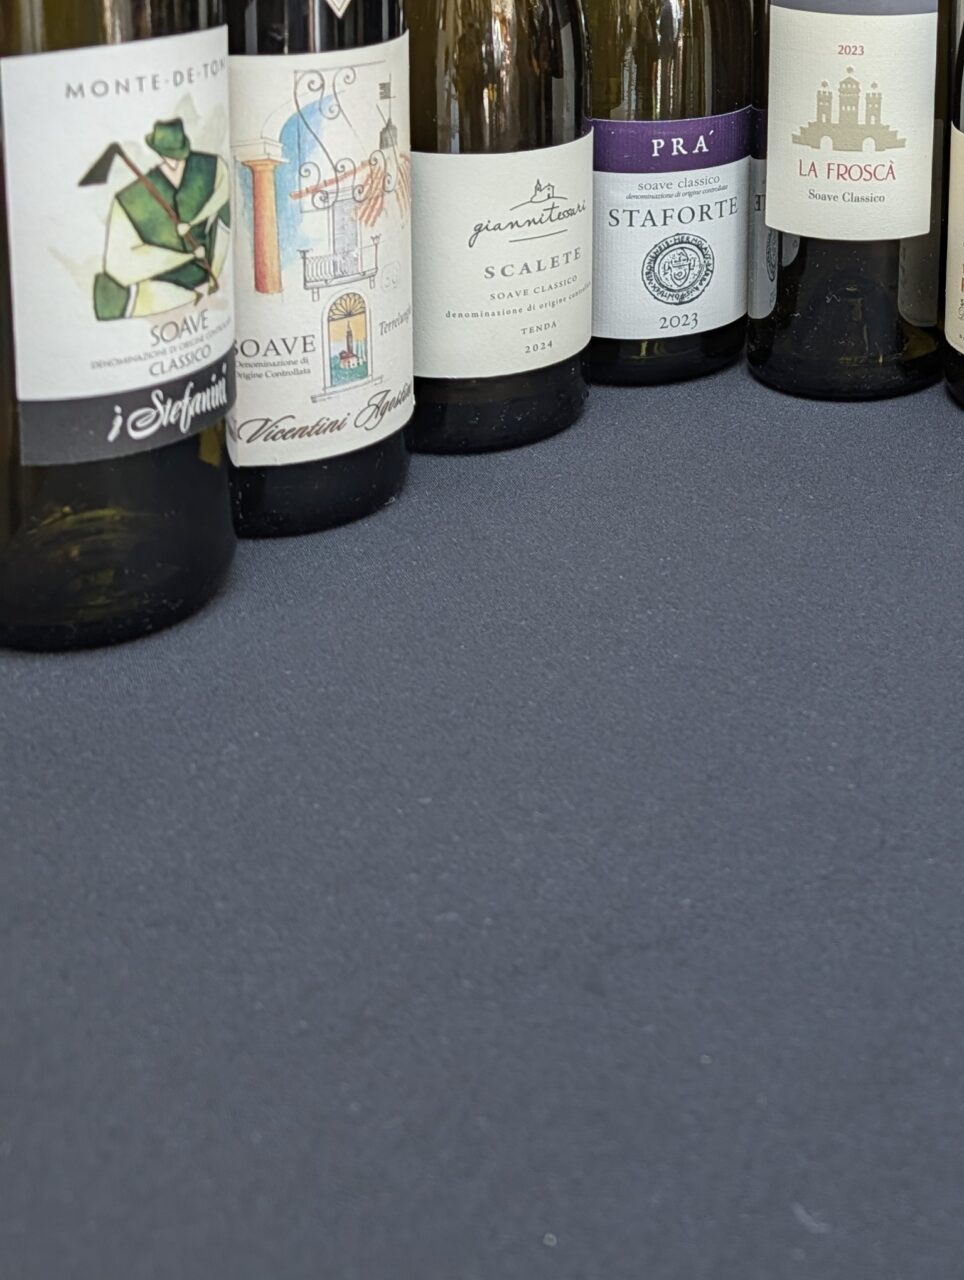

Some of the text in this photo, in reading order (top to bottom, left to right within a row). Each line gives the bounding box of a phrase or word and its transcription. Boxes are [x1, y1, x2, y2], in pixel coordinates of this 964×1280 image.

[837, 44, 865, 56] 2023
[798, 158, 897, 182] LA FROSCÀ
[638, 175, 720, 191] soave classico
[807, 188, 886, 204] Soave Classico
[607, 196, 739, 228] STAFORTE
[483, 247, 582, 279] SCALETE
[489, 275, 578, 301] SOAVE CLASSICO
[445, 307, 523, 319] denominazione
[526, 303, 537, 313] di
[538, 296, 567, 309] origine
[150, 308, 210, 348] SOAVE
[520, 321, 558, 335] TENDA
[658, 312, 699, 330] 2023
[524, 340, 553, 354] 2024
[149, 344, 212, 377] CLASSICO
[264, 367, 312, 379] Controllata
[237, 412, 352, 445] Vicentini
